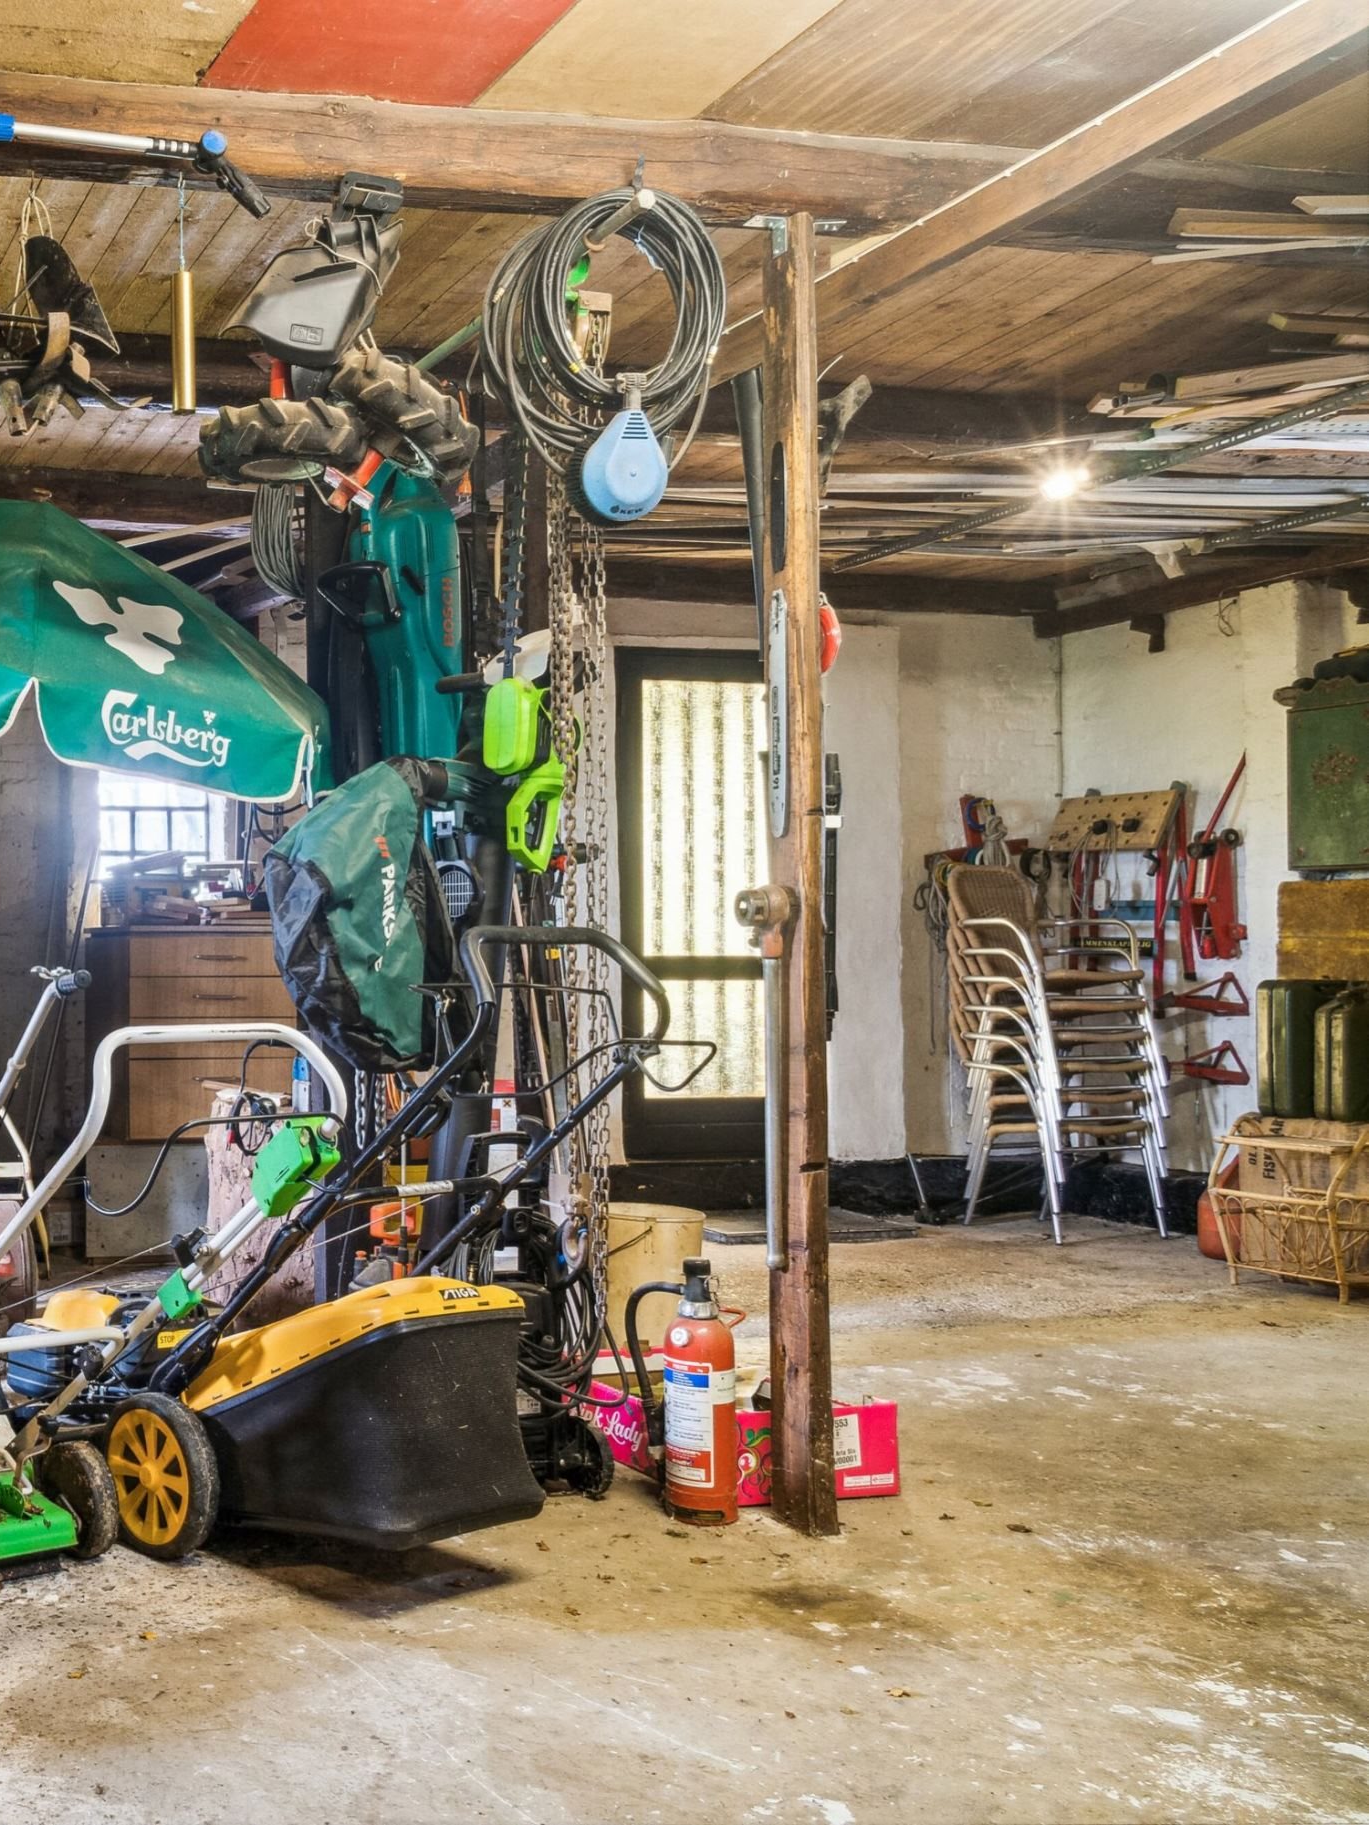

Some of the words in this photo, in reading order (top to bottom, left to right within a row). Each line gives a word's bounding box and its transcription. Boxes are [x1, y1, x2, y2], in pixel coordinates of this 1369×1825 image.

[442, 577, 454, 647] BOSCH
[101, 689, 232, 767] Carlsberg
[159, 1335, 176, 1344] STOP
[603, 1411, 644, 1452] Lady
